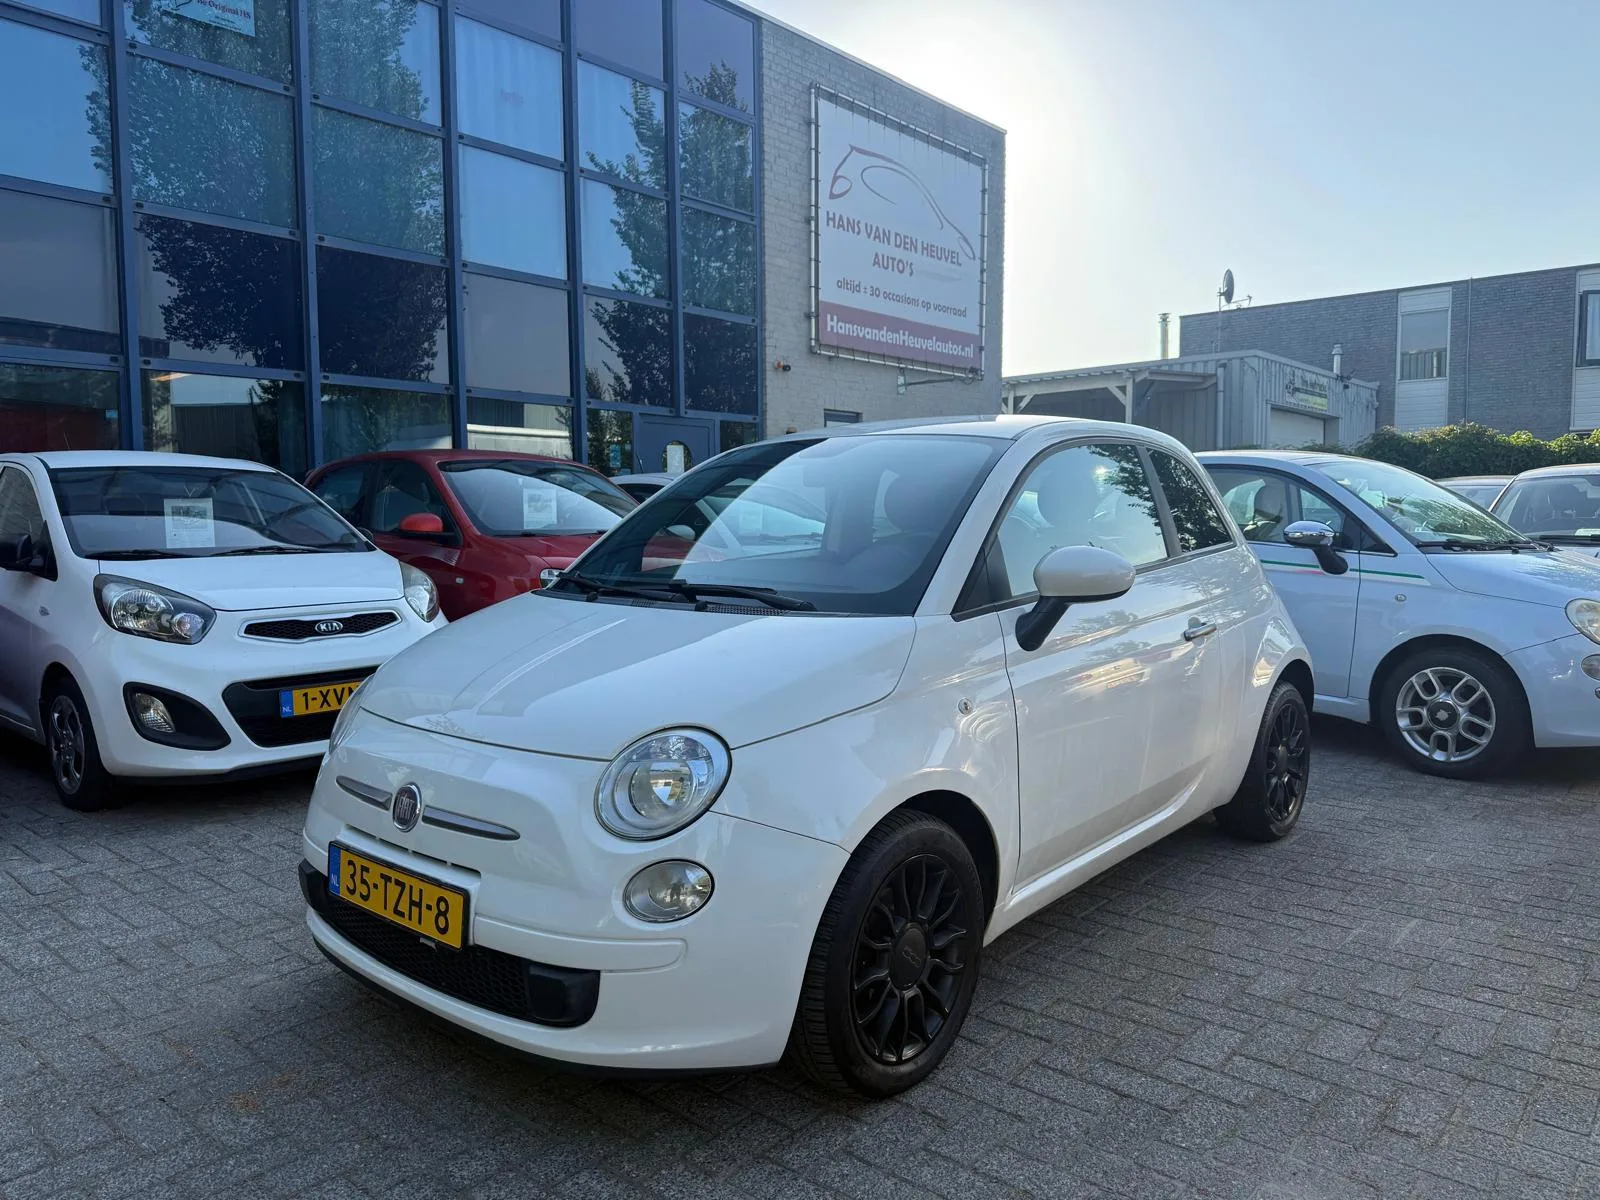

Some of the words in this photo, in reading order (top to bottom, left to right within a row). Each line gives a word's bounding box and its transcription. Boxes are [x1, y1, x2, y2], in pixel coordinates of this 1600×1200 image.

[826, 211, 861, 236] HANS
[865, 222, 891, 246] VAN
[894, 233, 918, 254] DEN
[921, 241, 962, 266] HEUVEL
[873, 252, 914, 277] AUTO'S
[836, 277, 861, 294] altijd
[869, 286, 881, 298] 30
[882, 291, 920, 307] occasions
[921, 299, 932, 312] op
[932, 304, 967, 318] voorraad
[827, 313, 974, 358] HansvandenHeuvelautos.nl
[320, 622, 340, 632] KIA
[331, 875, 339, 887] NL
[346, 859, 449, 935] 35-TZH-8
